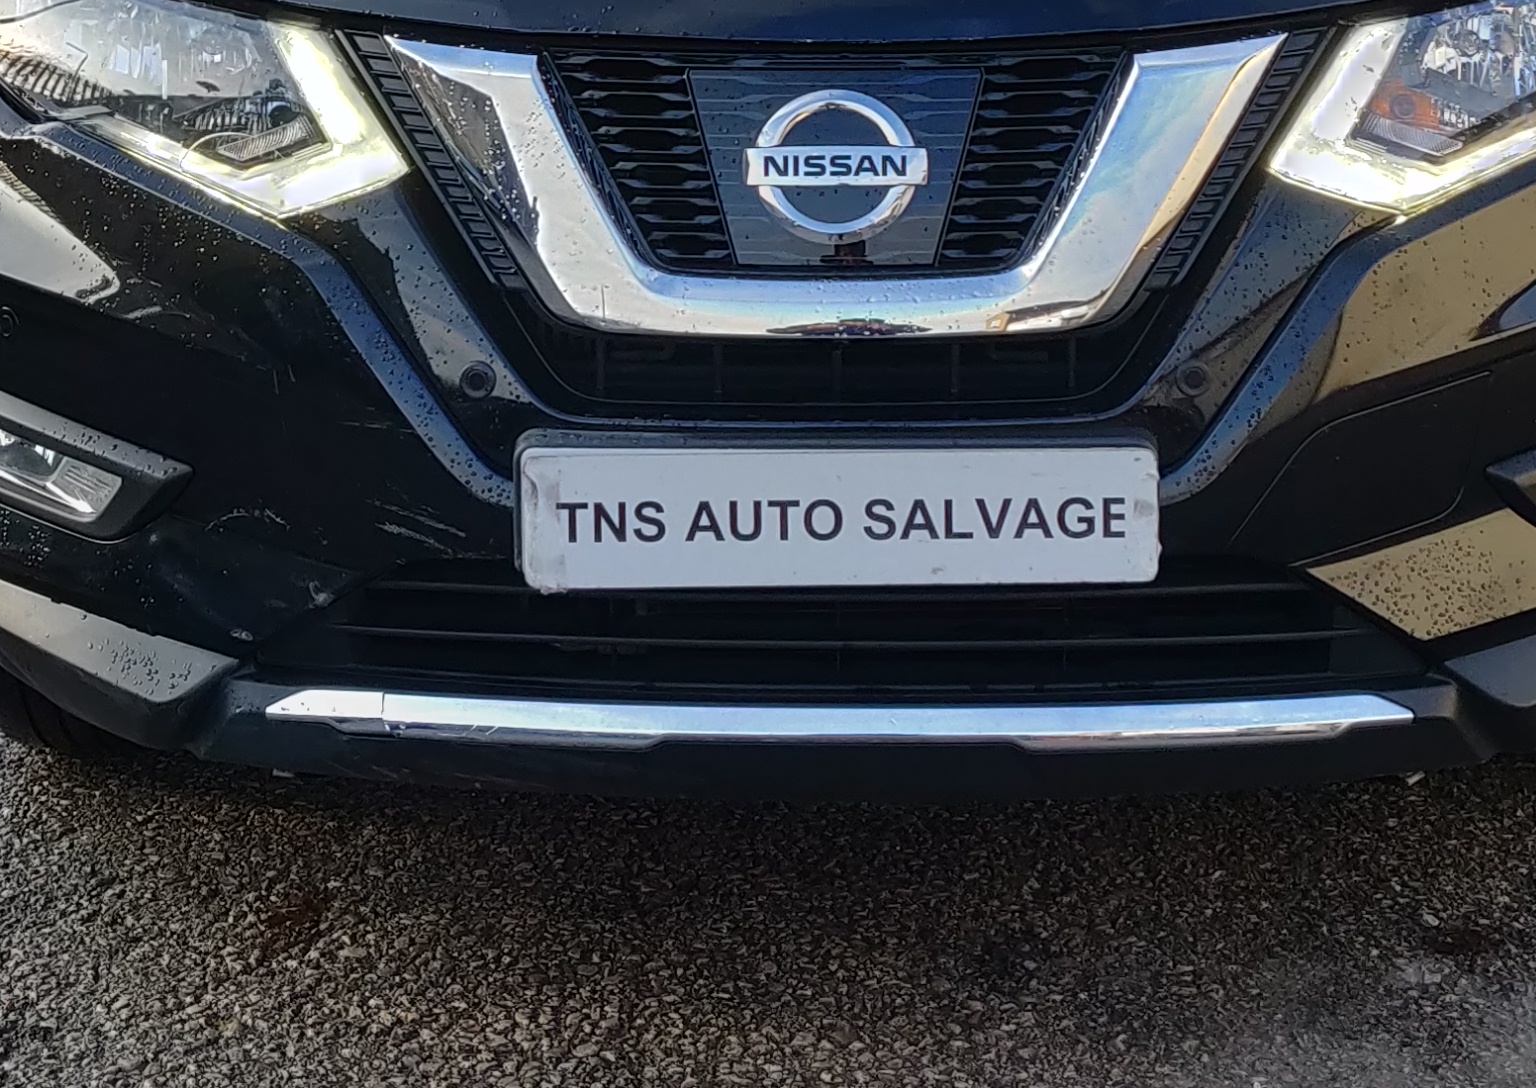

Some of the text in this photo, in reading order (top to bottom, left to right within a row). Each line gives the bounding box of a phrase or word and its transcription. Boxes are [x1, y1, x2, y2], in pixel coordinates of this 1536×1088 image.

[763, 155, 907, 177] NISSAN
[555, 497, 1127, 544] TNS AUTO SALVAGE
